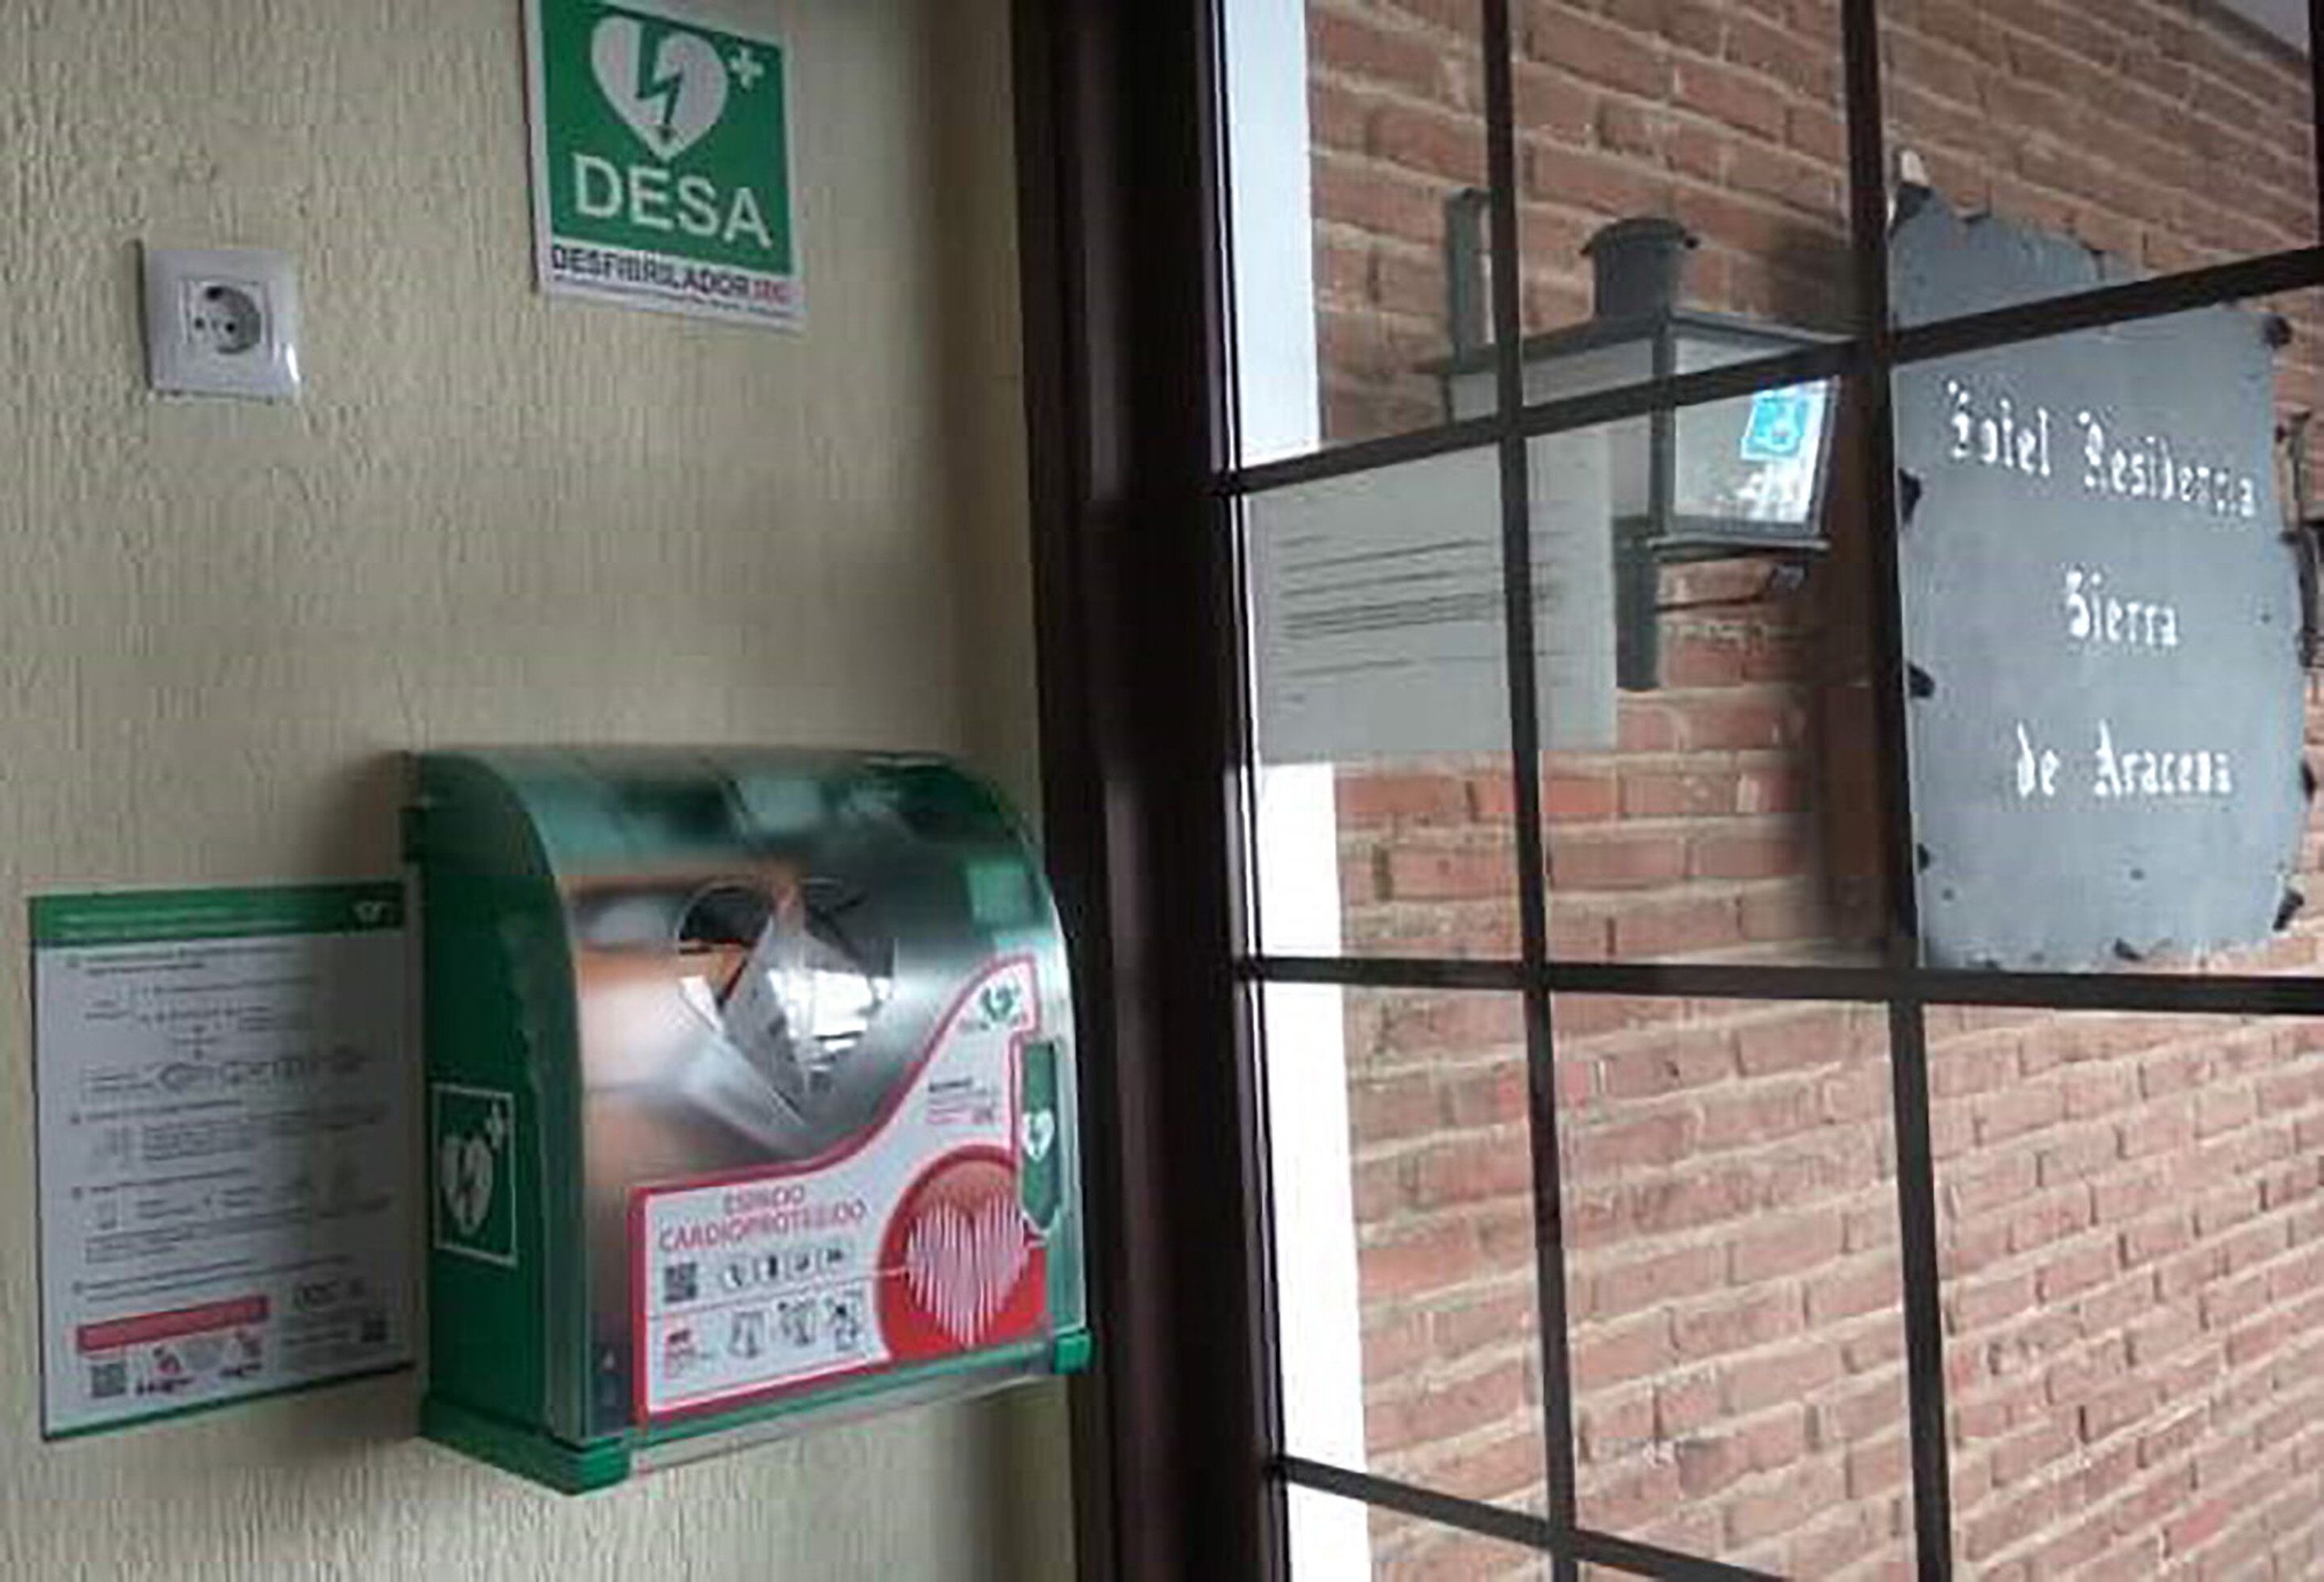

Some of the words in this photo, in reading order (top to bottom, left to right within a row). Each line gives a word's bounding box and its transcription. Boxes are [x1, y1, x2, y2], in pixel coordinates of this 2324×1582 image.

[574, 152, 773, 248] DESA
[2065, 570, 2177, 646] Sierra
[2017, 721, 2059, 797] de
[2095, 718, 2232, 796] Aracena
